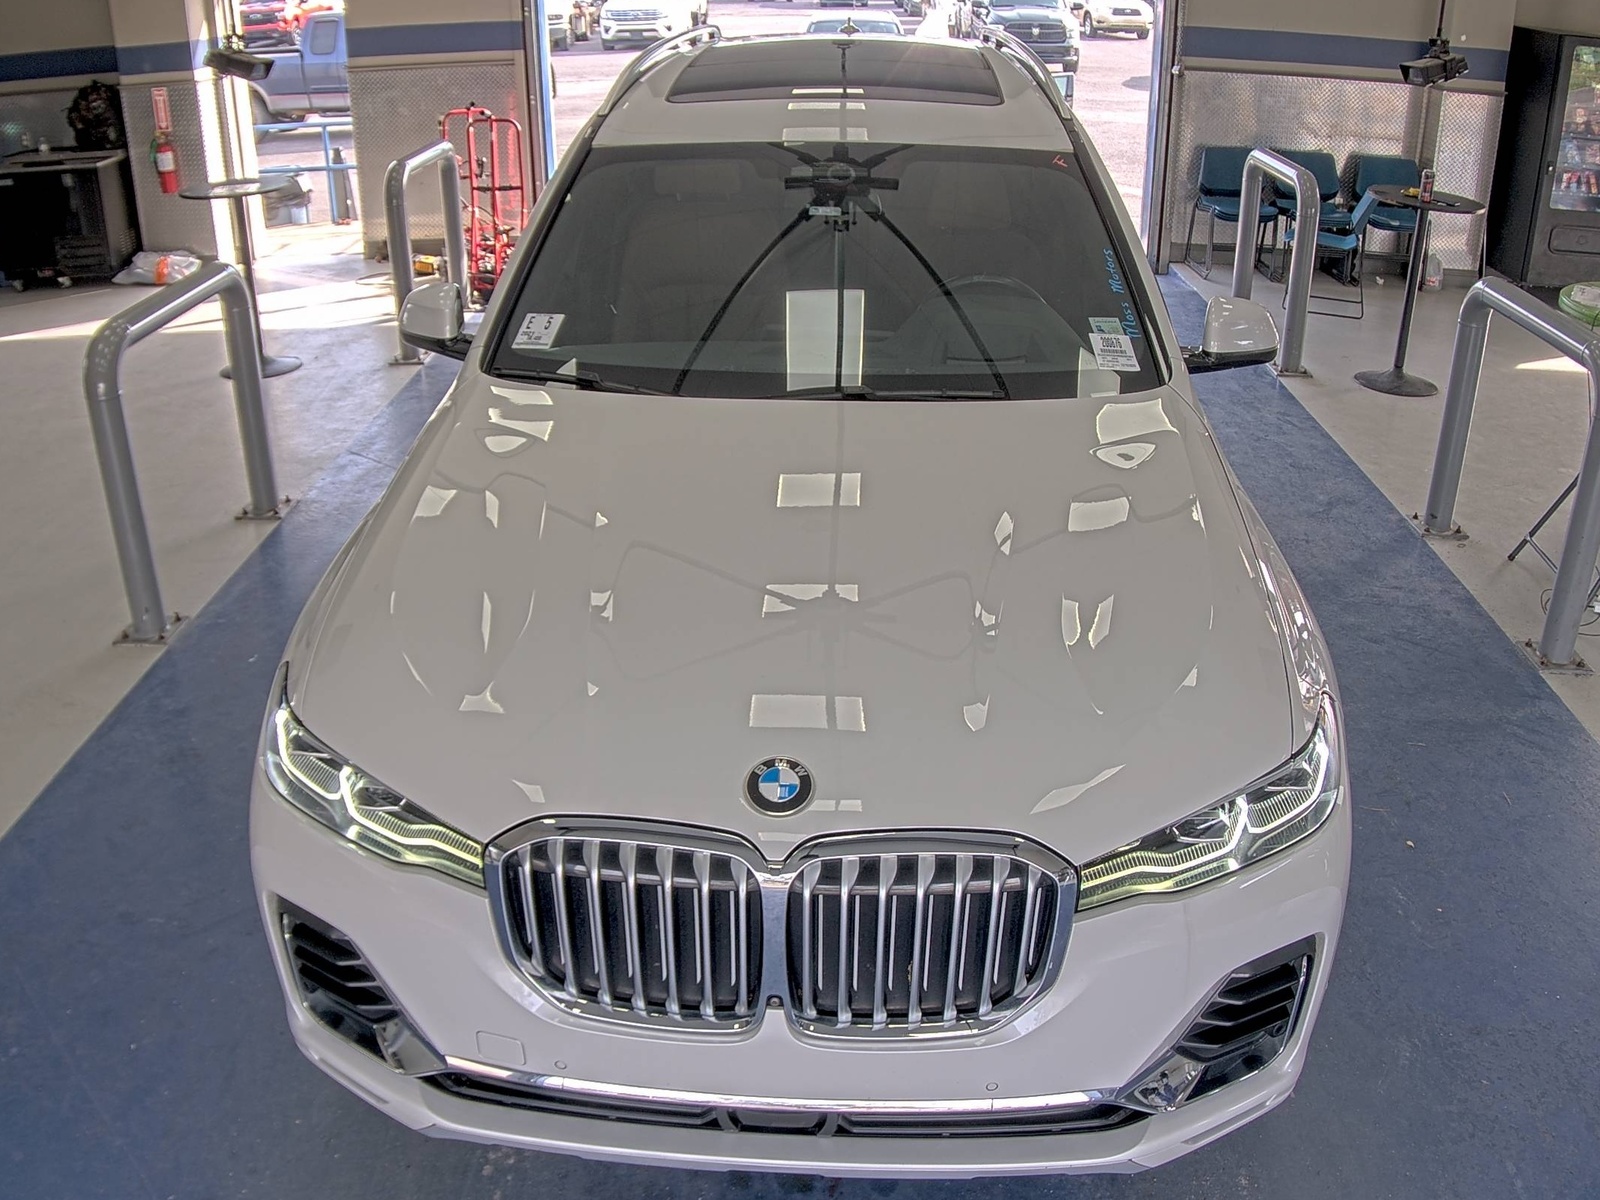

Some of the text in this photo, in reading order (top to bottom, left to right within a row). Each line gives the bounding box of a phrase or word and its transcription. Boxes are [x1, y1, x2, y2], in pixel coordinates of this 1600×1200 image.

[1103, 248, 1142, 338] Moss Motors
[526, 316, 554, 330] E 5
[754, 759, 808, 777] BMW
